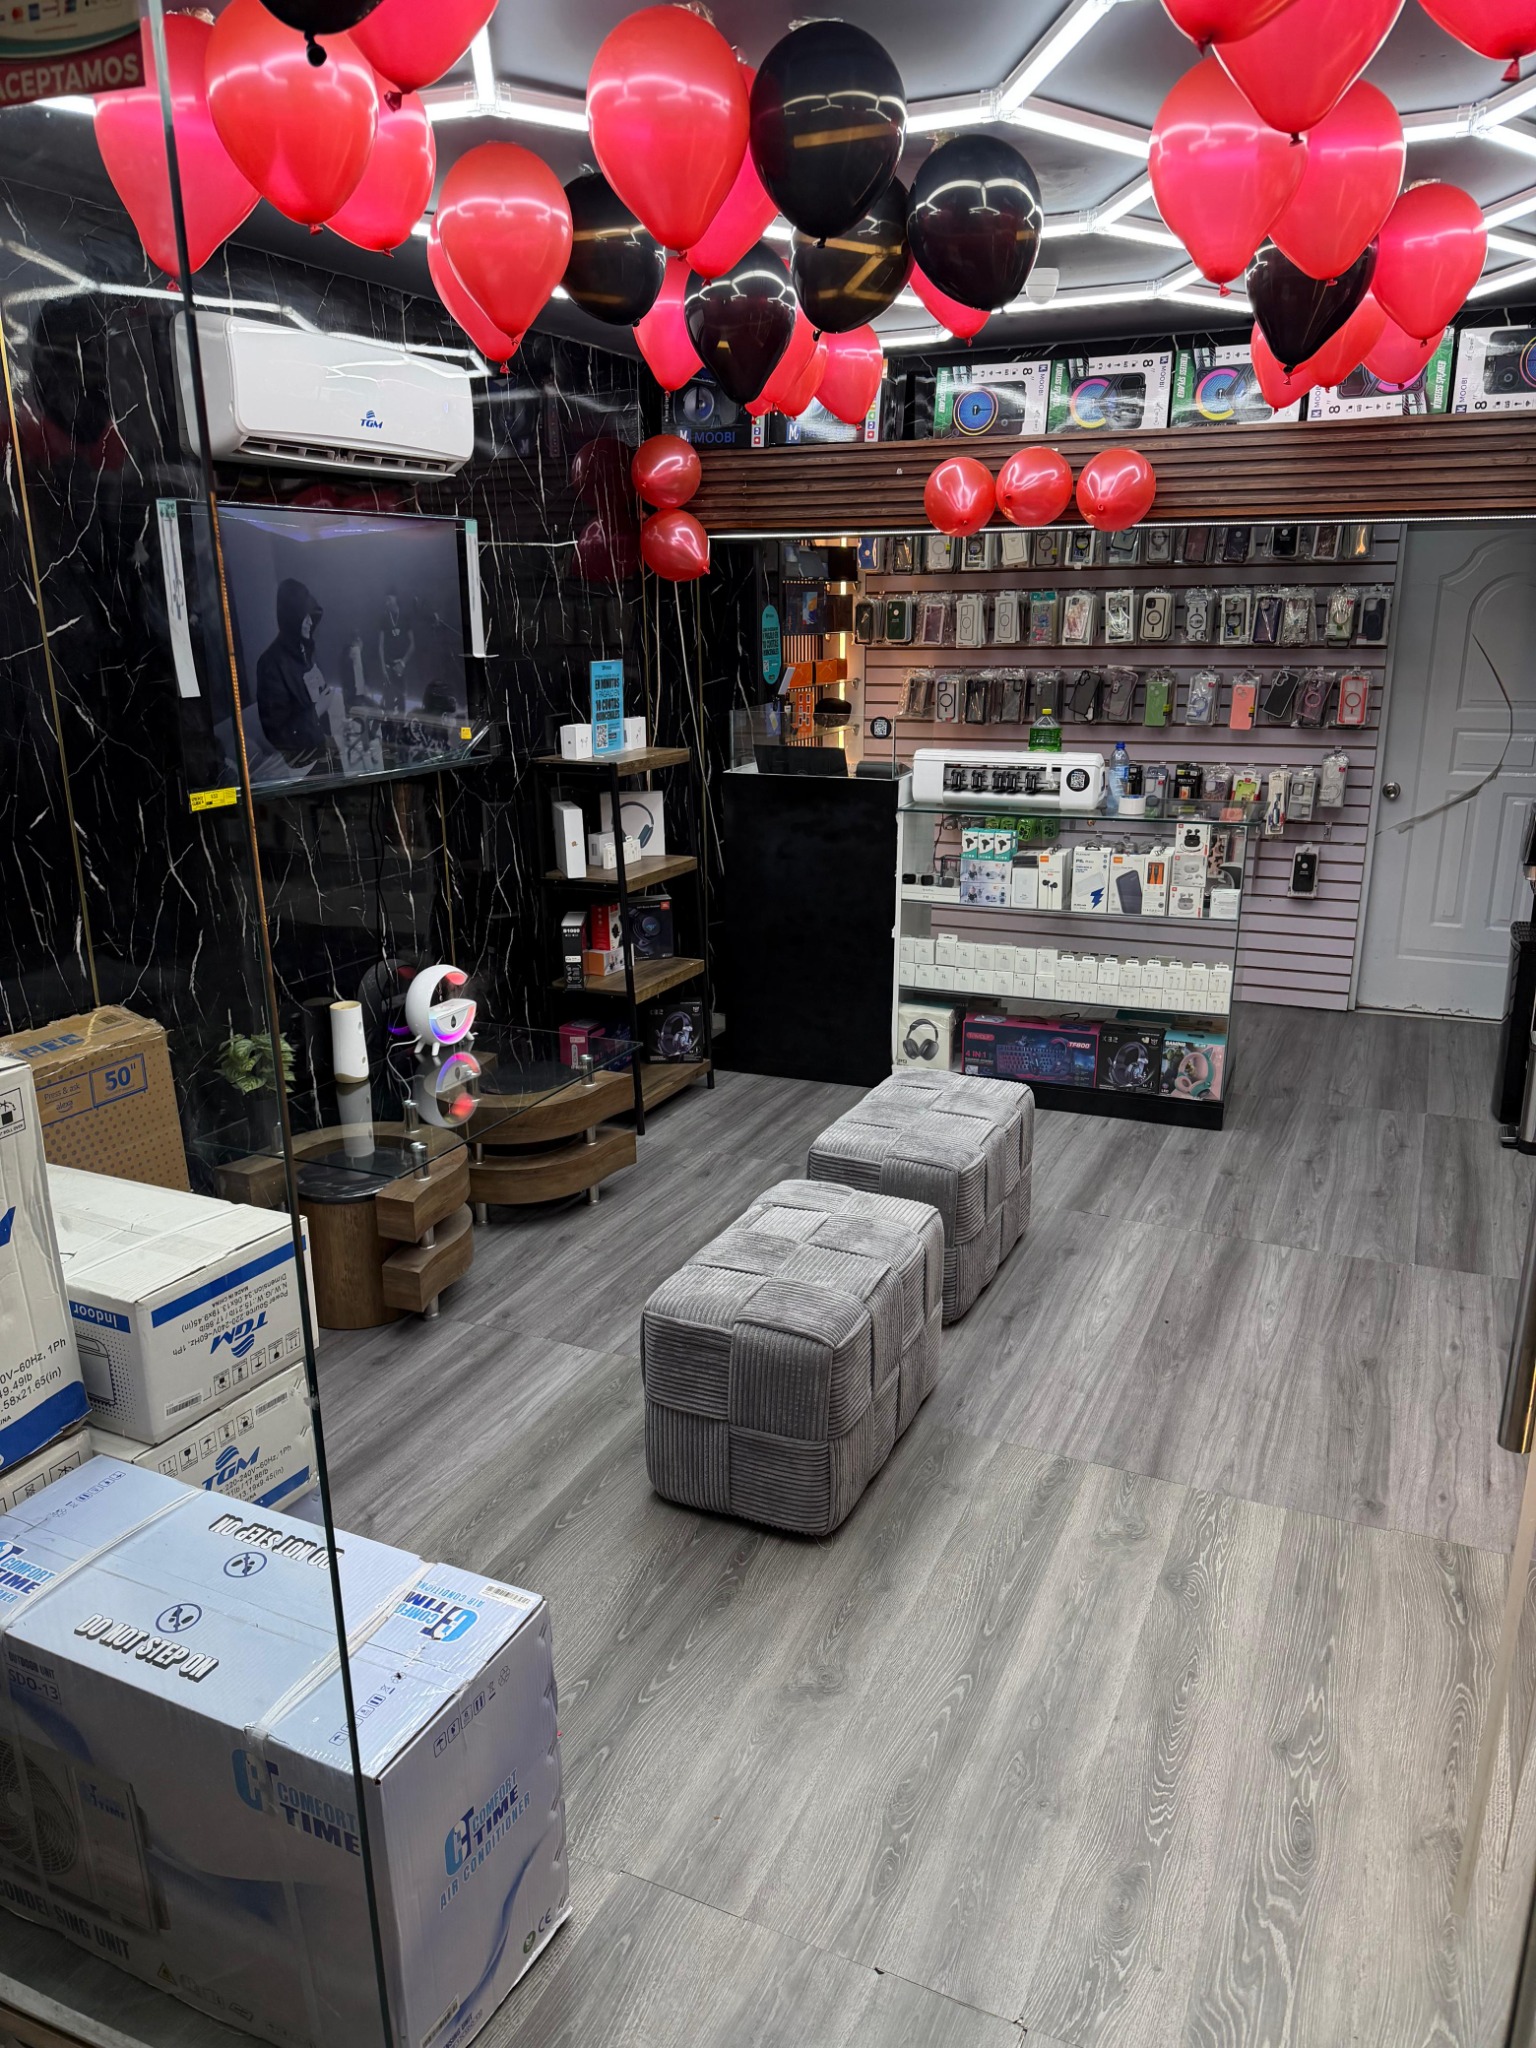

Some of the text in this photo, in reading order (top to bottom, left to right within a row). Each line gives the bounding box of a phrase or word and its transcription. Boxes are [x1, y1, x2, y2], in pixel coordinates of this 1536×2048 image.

[0, 53, 139, 99] CEPTAMOS
[1038, 373, 1046, 396] MOOBI
[1159, 365, 1167, 388] MOOBI
[1459, 377, 1468, 403] MOOBI
[360, 417, 383, 429] TGM
[694, 431, 736, 444] MOOBI
[106, 1063, 135, 1091] 50"
[44, 1091, 61, 1100] Press
[70, 1083, 80, 1093] ask
[57, 1101, 73, 1109] alexa
[211, 1296, 227, 1308] CHINA
[234, 1285, 248, 1297] MADE
[268, 1290, 288, 1306] Power
[73, 1302, 118, 1329] Indoor
[210, 1311, 269, 1355] TGM
[0, 1337, 67, 1385] 0V~60Hz, 1Ph
[1, 1366, 63, 1412] .58x21.65(in)
[202, 1446, 260, 1490] TGM
[208, 1513, 243, 1537] ON
[234, 1522, 283, 1550] STEP
[272, 1534, 318, 1562] NOT
[1, 1557, 55, 1583] COMFORT
[394, 1603, 440, 1625] COMFO
[403, 1591, 448, 1614] TIM
[469, 1598, 485, 1608] AIR
[74, 1613, 219, 1683] DO NOT STEP ON
[9, 1669, 58, 1700] SDO-13
[276, 1781, 357, 1834] COMFORT
[471, 1768, 518, 1833] COMFORT
[472, 1784, 519, 1846] TIME
[279, 1802, 361, 1857] TIME
[440, 1790, 531, 1912] AIR CONDITIONER
[93, 1924, 130, 1961] UNIT
